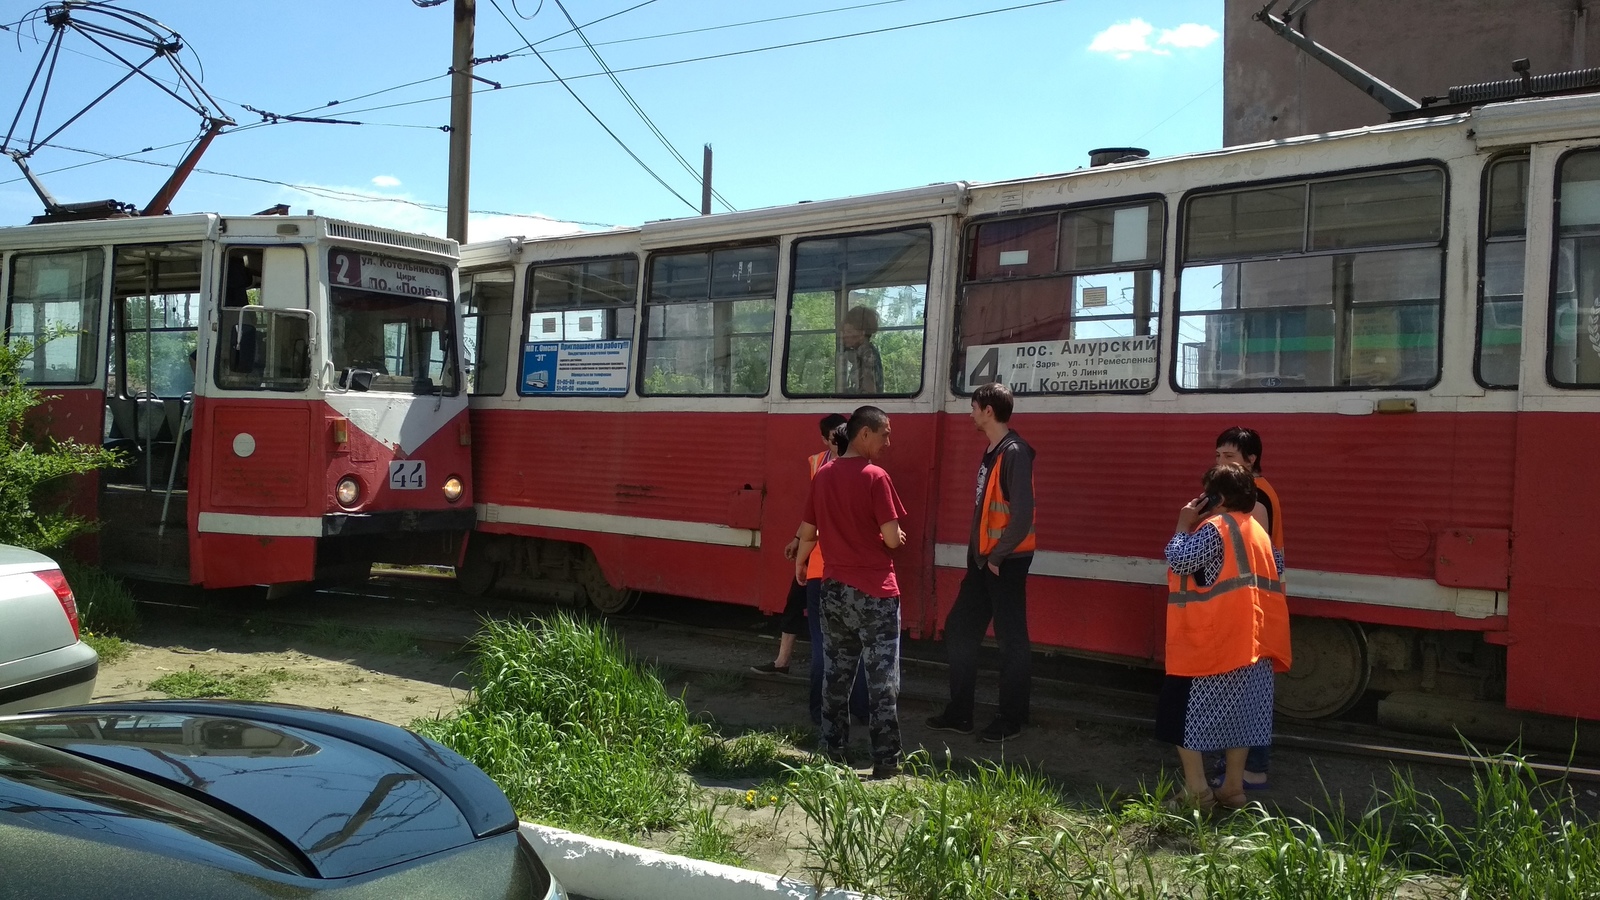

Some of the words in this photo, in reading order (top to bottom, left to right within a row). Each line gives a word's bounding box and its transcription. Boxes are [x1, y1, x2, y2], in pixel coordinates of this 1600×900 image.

[336, 254, 350, 284] 2
[361, 256, 377, 267] ул.
[380, 259, 445, 276] Котельникова
[396, 271, 417, 282] Цирк
[396, 282, 443, 297] «Полёт»
[560, 343, 595, 351] Приглашаем
[1016, 345, 1053, 357] пос.
[1060, 336, 1156, 357] Амурский
[969, 347, 1003, 387] 4
[1011, 362, 1029, 370] маг.
[1031, 360, 1060, 370] «Заря»
[1068, 360, 1081, 368] ул.
[1085, 358, 1094, 366] 11
[1097, 357, 1157, 366] Ремесленная
[1080, 368, 1108, 376] Линия
[1009, 382, 1032, 393] ул.
[392, 462, 424, 488] 44
